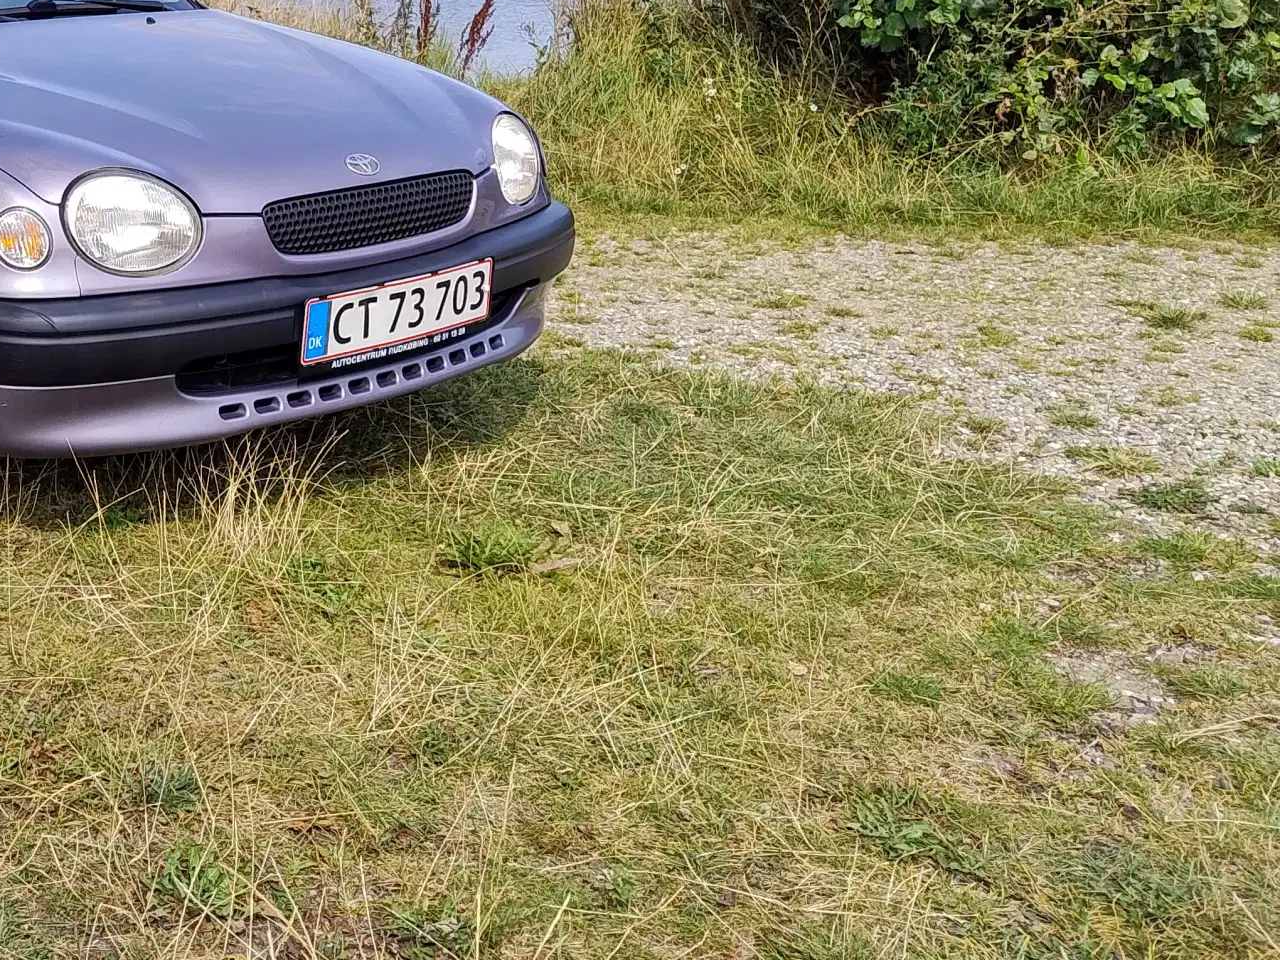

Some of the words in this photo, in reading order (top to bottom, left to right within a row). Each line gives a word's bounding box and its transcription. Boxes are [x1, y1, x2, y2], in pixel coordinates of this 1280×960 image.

[333, 296, 378, 344] CT
[388, 288, 425, 333] 73
[434, 270, 486, 322] 703
[308, 335, 323, 350] DK
[331, 348, 387, 369] AUTOCENTRUM
